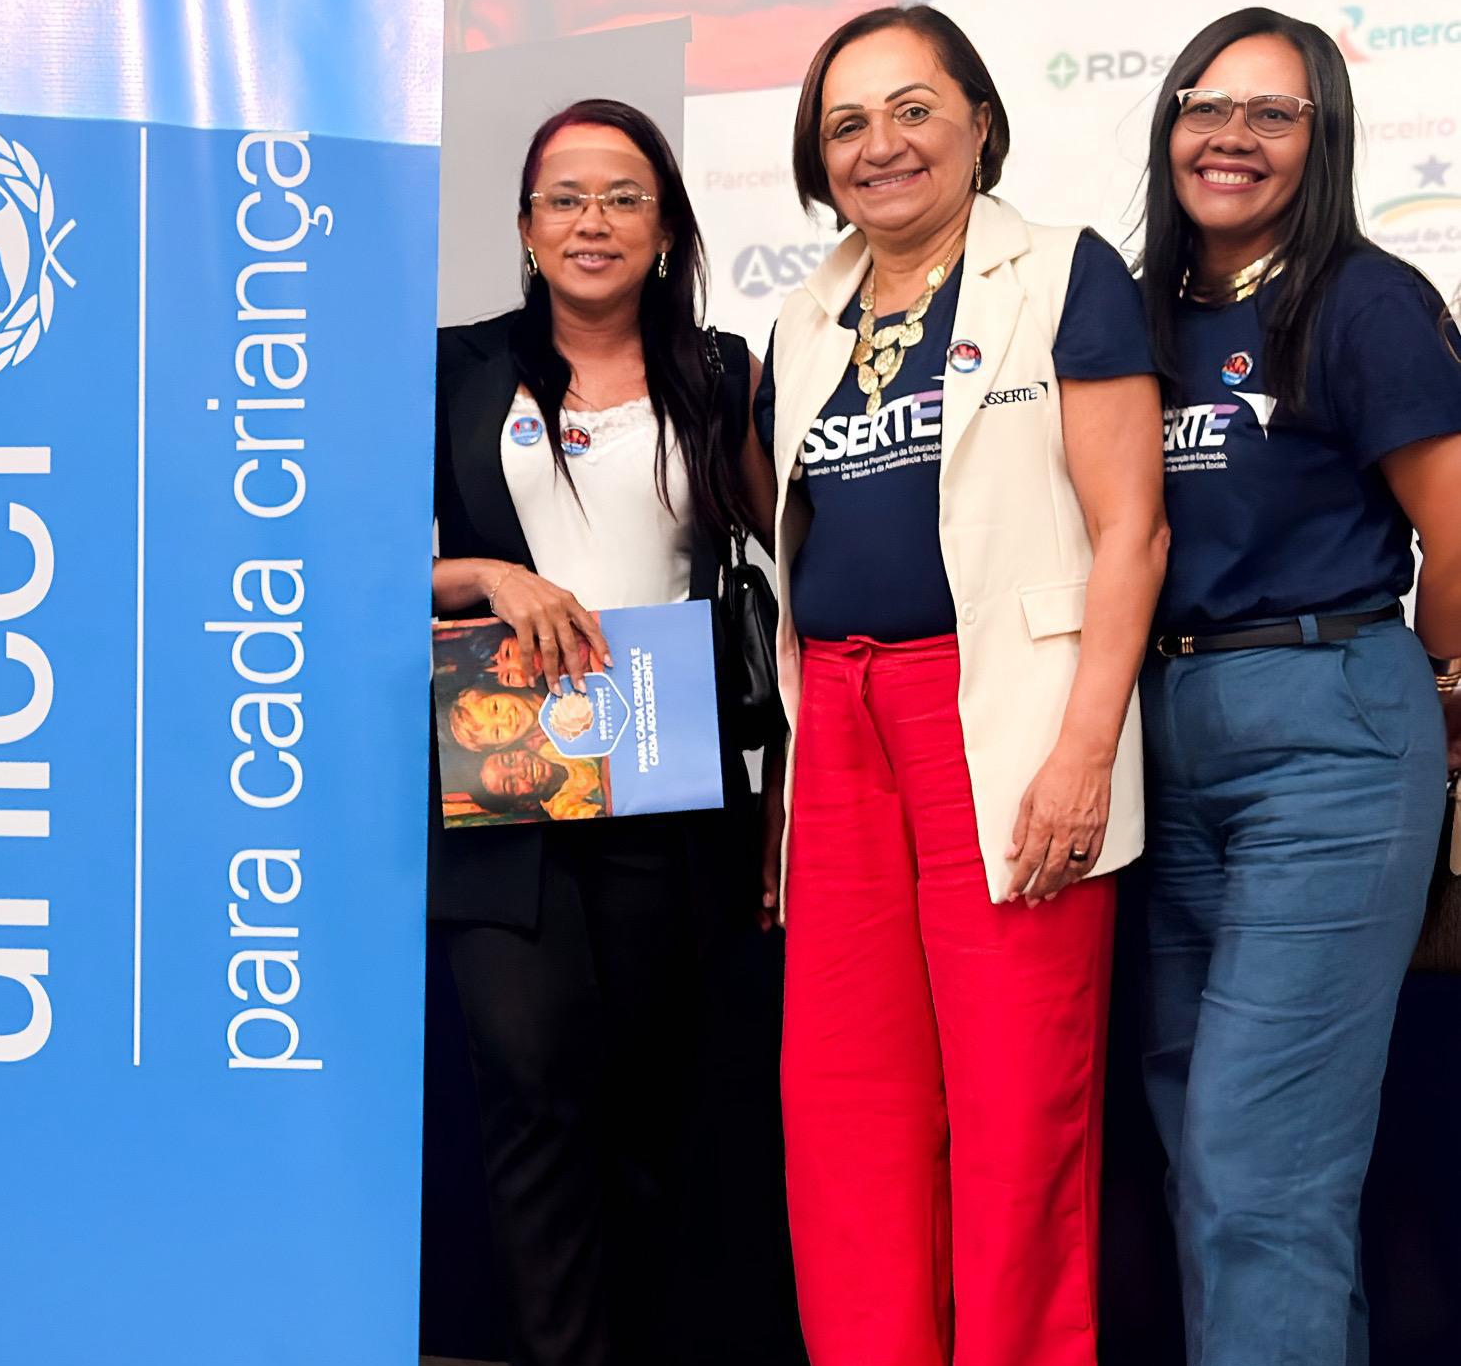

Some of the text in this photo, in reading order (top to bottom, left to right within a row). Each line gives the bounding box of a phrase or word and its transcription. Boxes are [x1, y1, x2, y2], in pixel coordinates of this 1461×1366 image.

[204, 130, 334, 1069] para cada criança
[630, 647, 649, 772] PARA CADA CRIANÇA E
[642, 652, 659, 766] CADA ADOLESCENTE
